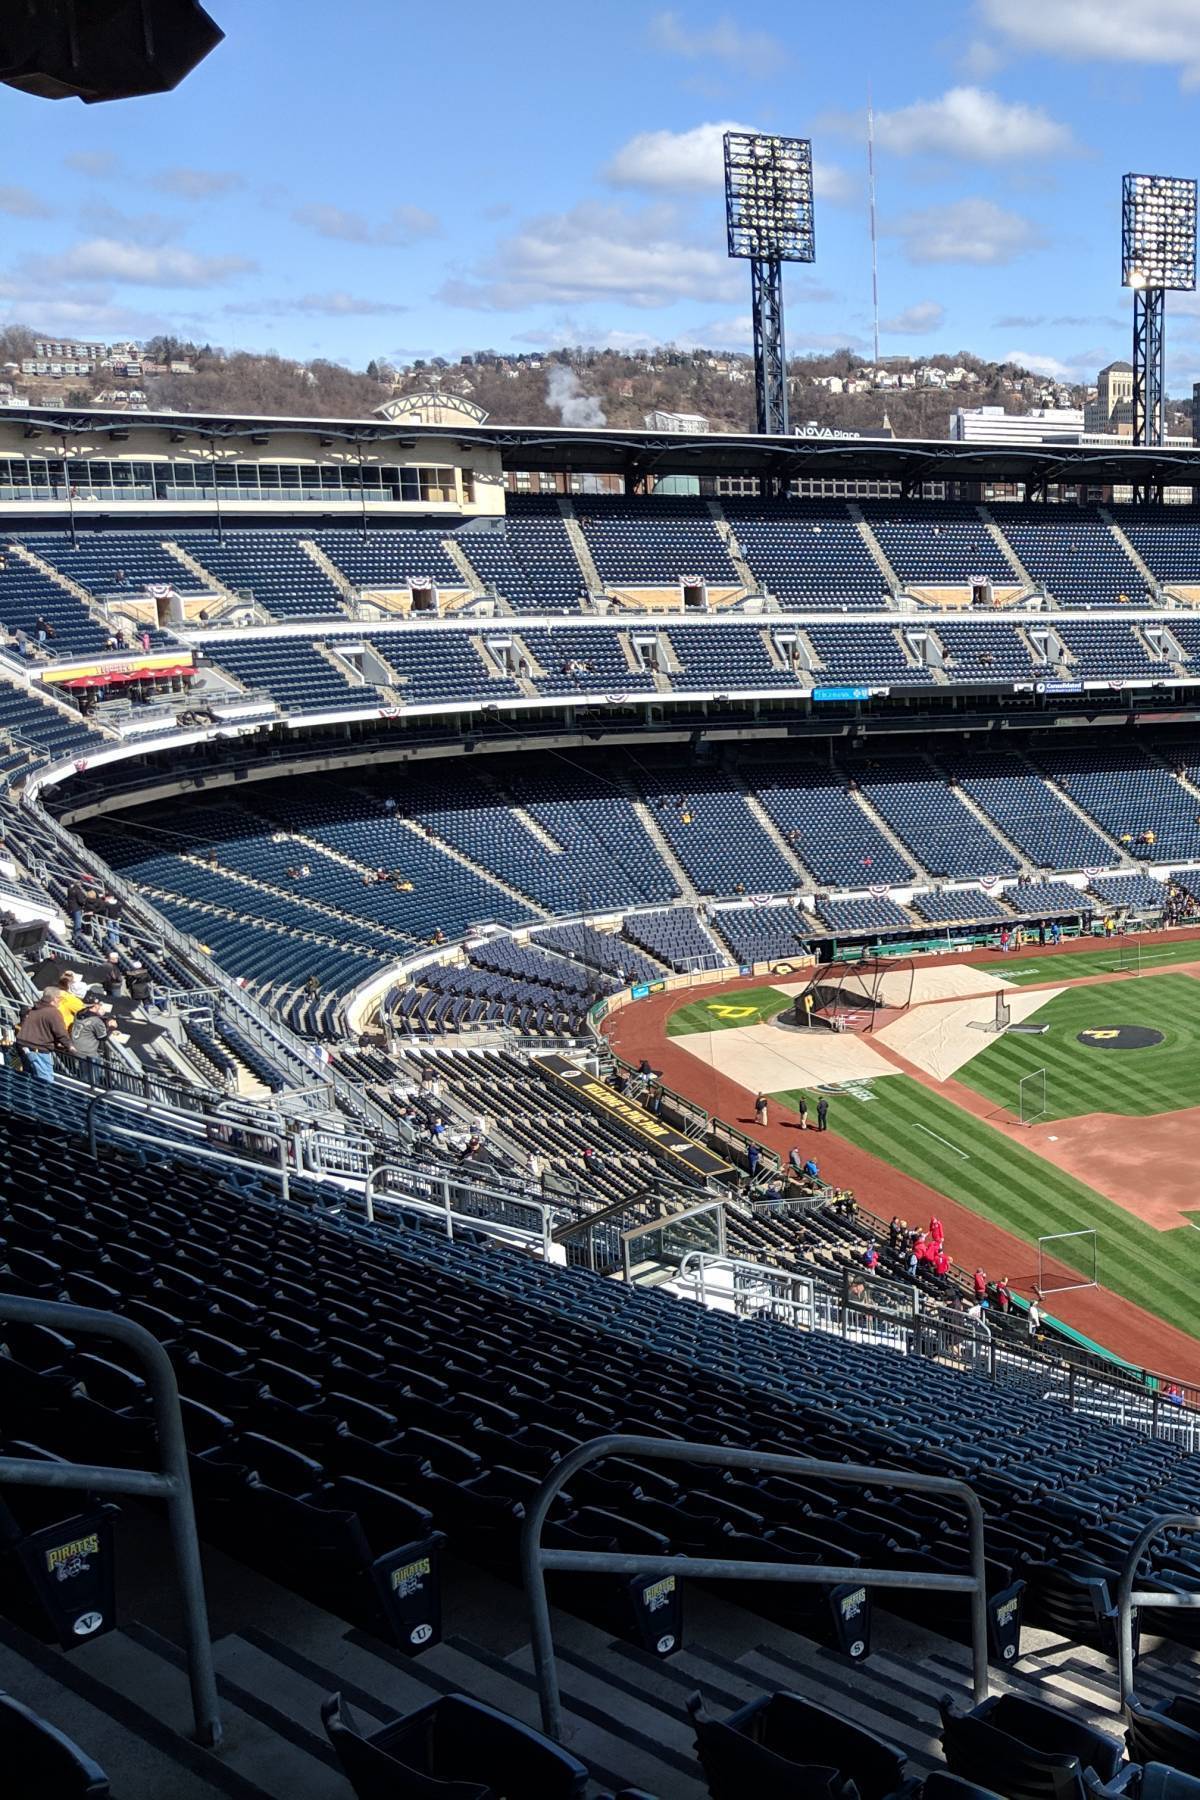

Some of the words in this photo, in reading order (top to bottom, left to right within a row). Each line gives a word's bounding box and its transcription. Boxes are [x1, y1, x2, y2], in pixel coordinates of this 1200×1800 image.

[623, 1110, 649, 1123] PNC
[638, 1121, 669, 1137] PARK
[46, 1534, 99, 1572] PIRATES
[81, 1616, 94, 1629] V
[415, 1627, 427, 1640] U
